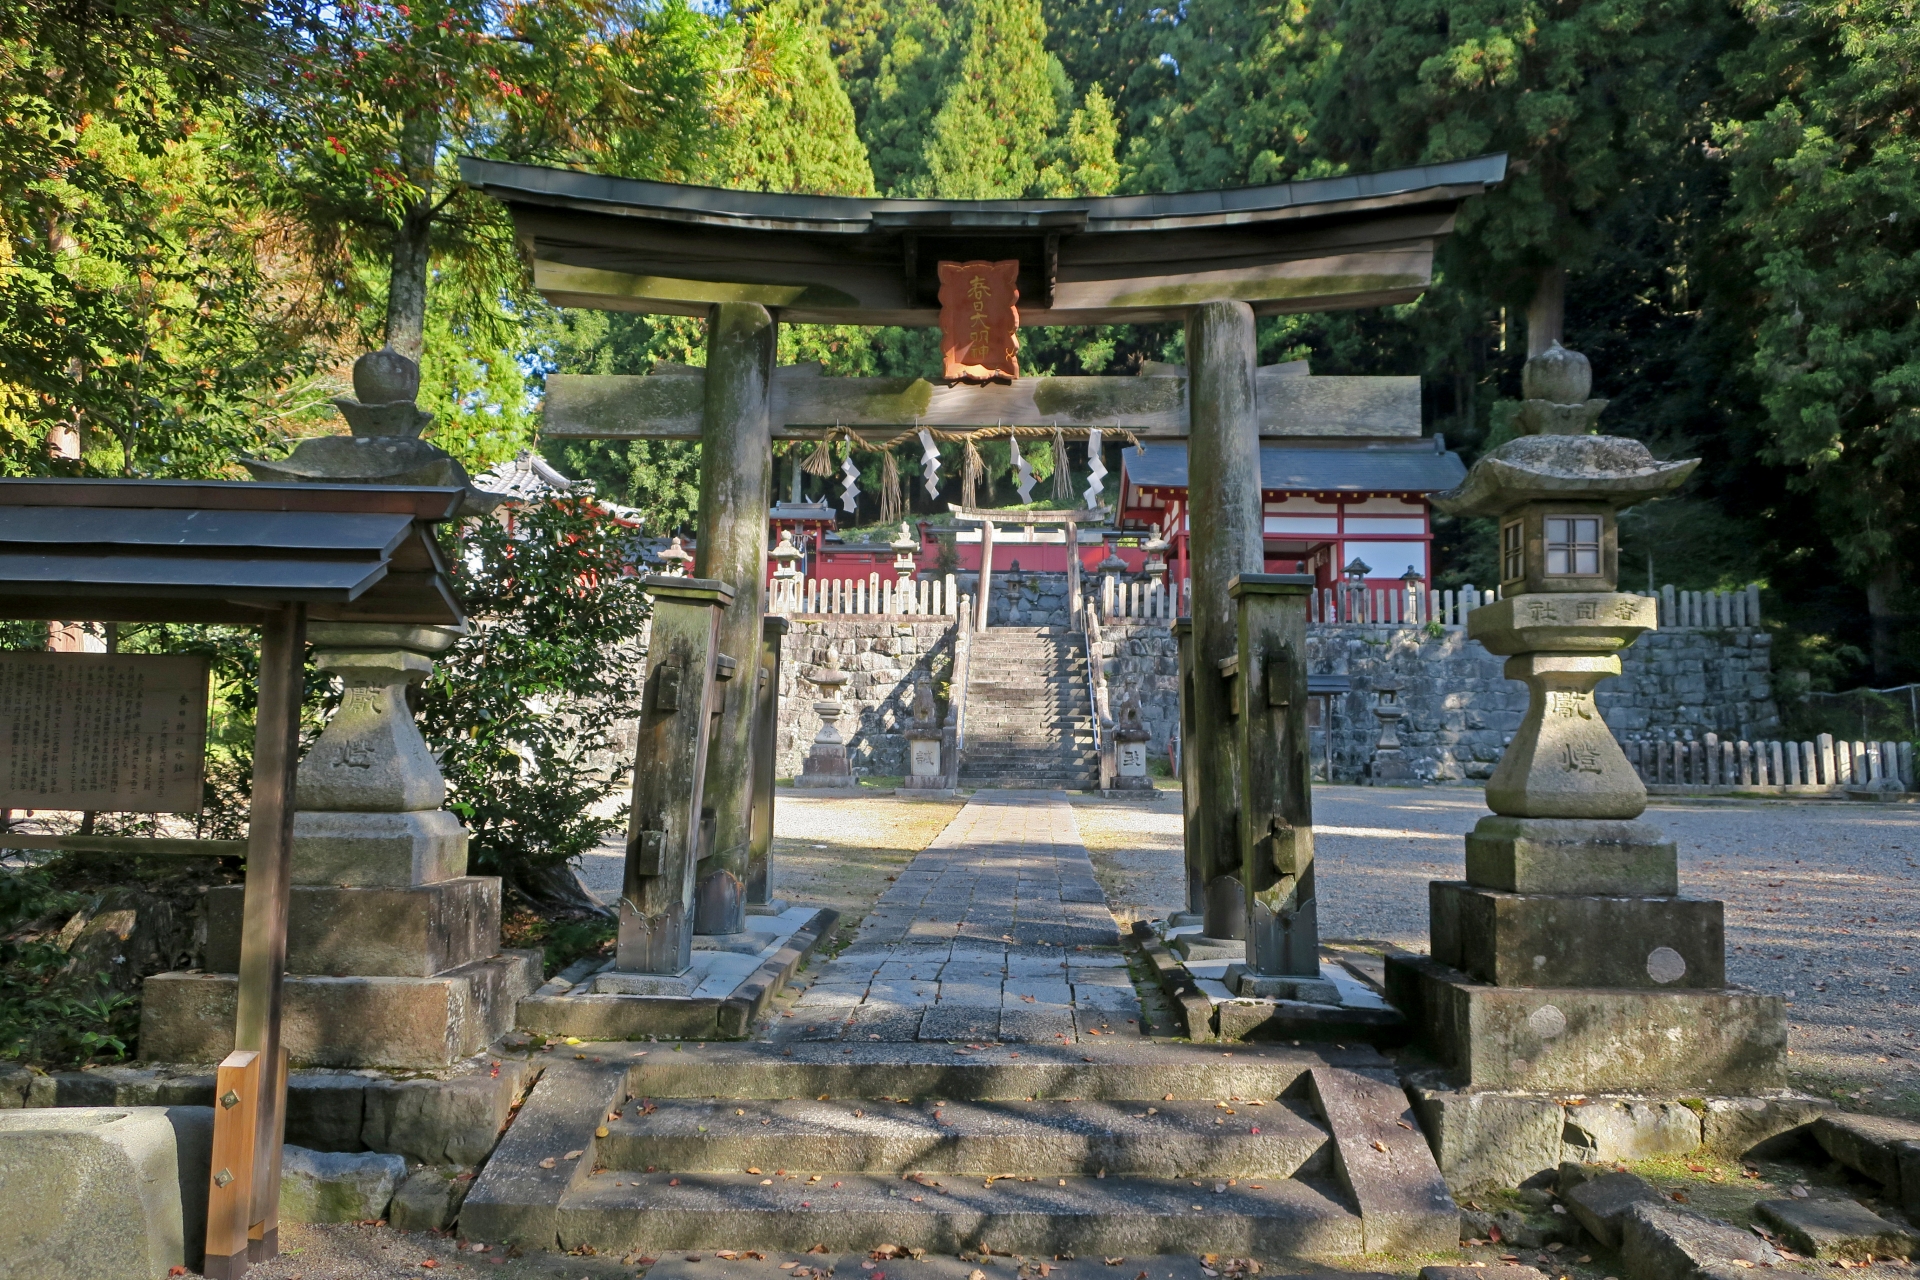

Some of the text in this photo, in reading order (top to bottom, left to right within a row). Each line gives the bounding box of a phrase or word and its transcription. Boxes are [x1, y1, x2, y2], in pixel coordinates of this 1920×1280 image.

[967, 275, 991, 360] 春日大明神
